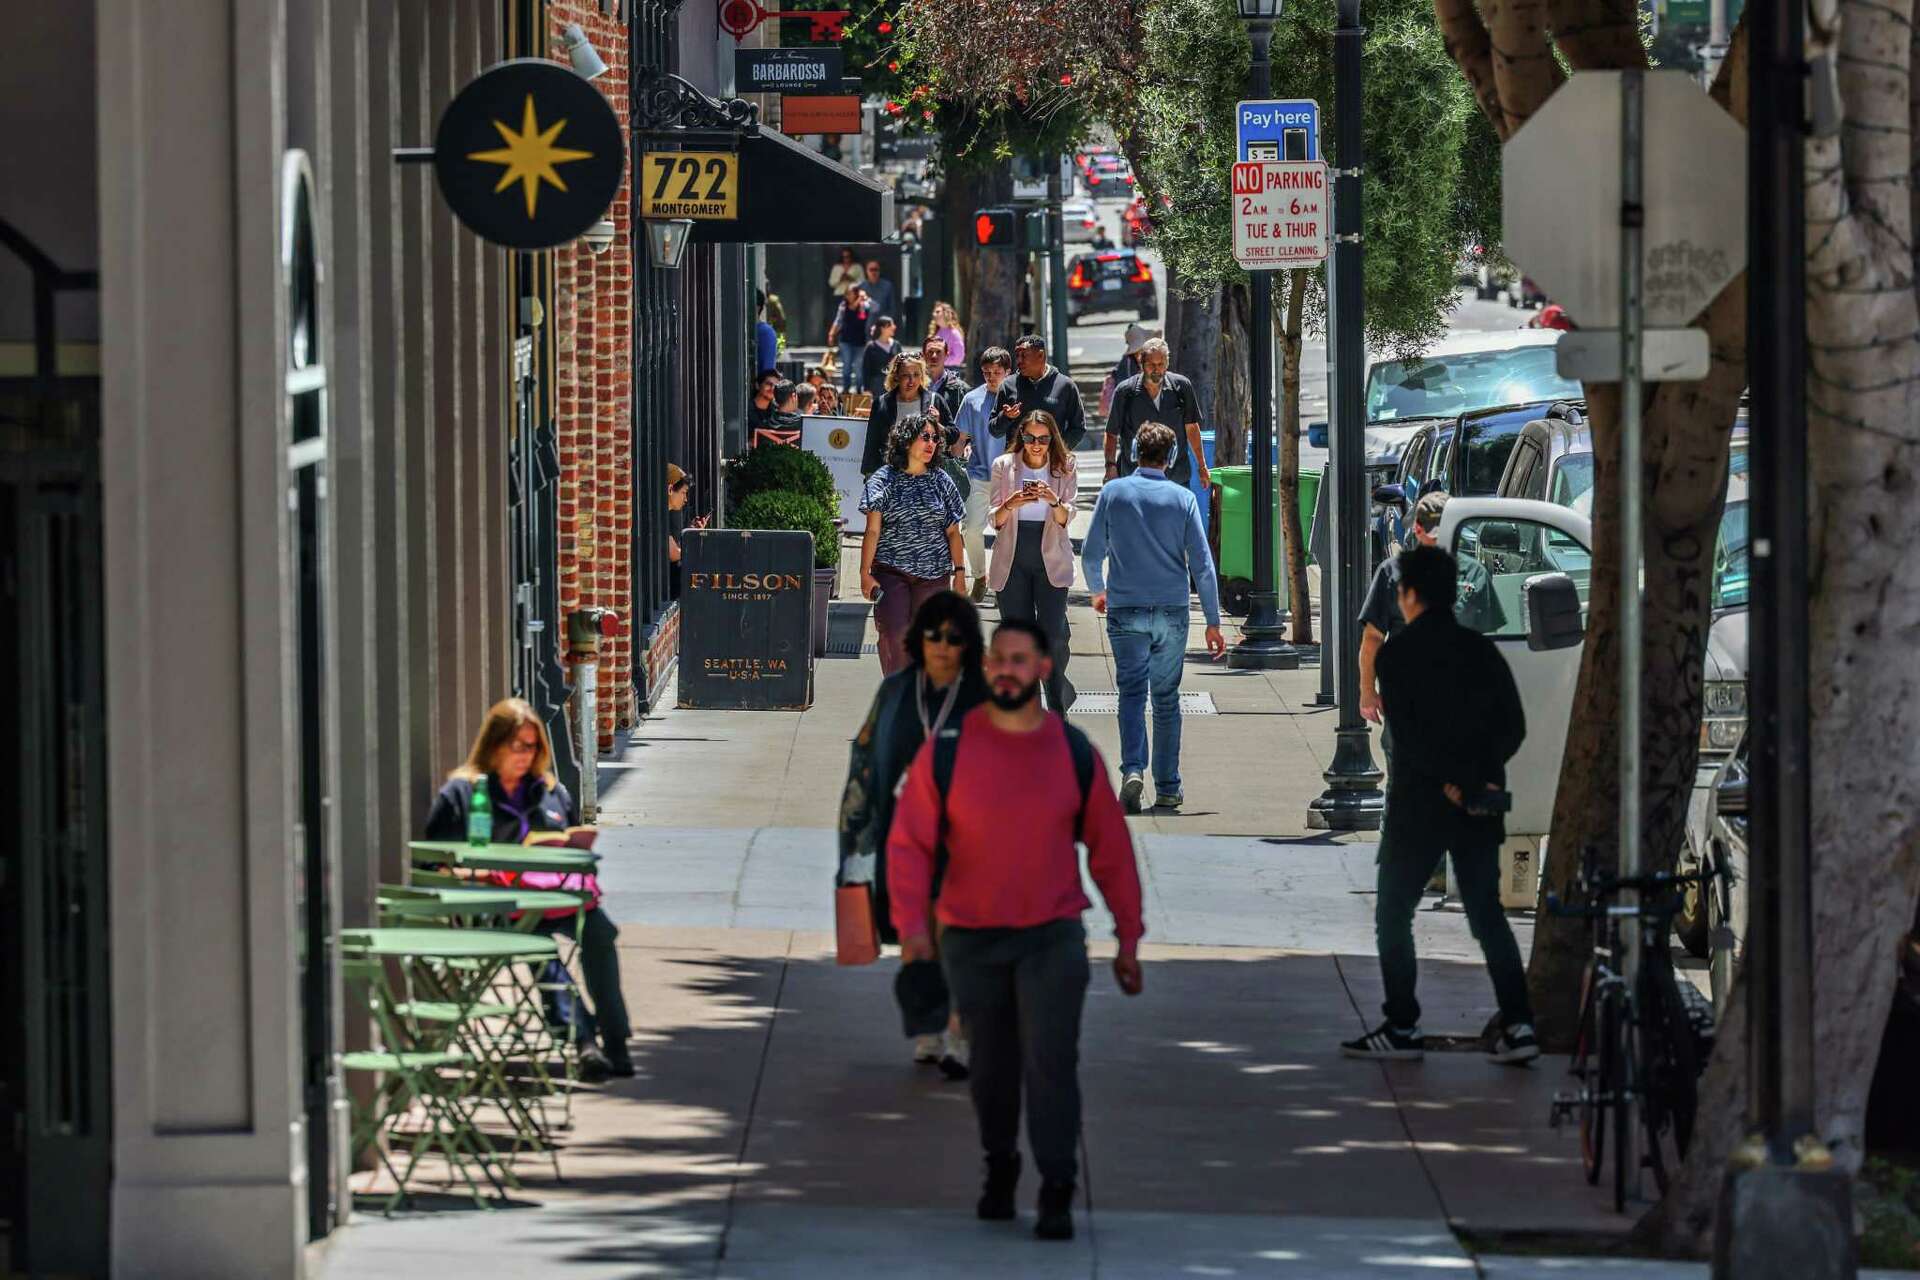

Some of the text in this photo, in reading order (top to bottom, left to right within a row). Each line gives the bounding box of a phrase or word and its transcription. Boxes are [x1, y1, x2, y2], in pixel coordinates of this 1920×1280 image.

[752, 63, 826, 81] BARBAROSSA
[1243, 109, 1311, 128] Pay here
[652, 157, 727, 200] 722
[1236, 165, 1322, 190] NO PARKING
[652, 202, 727, 215] MONTGOMERY
[1246, 222, 1317, 238] TUE & THUR
[1245, 245, 1318, 257] STREET CLEANING
[690, 573, 802, 590] FILSON
[768, 659, 787, 670] WA
